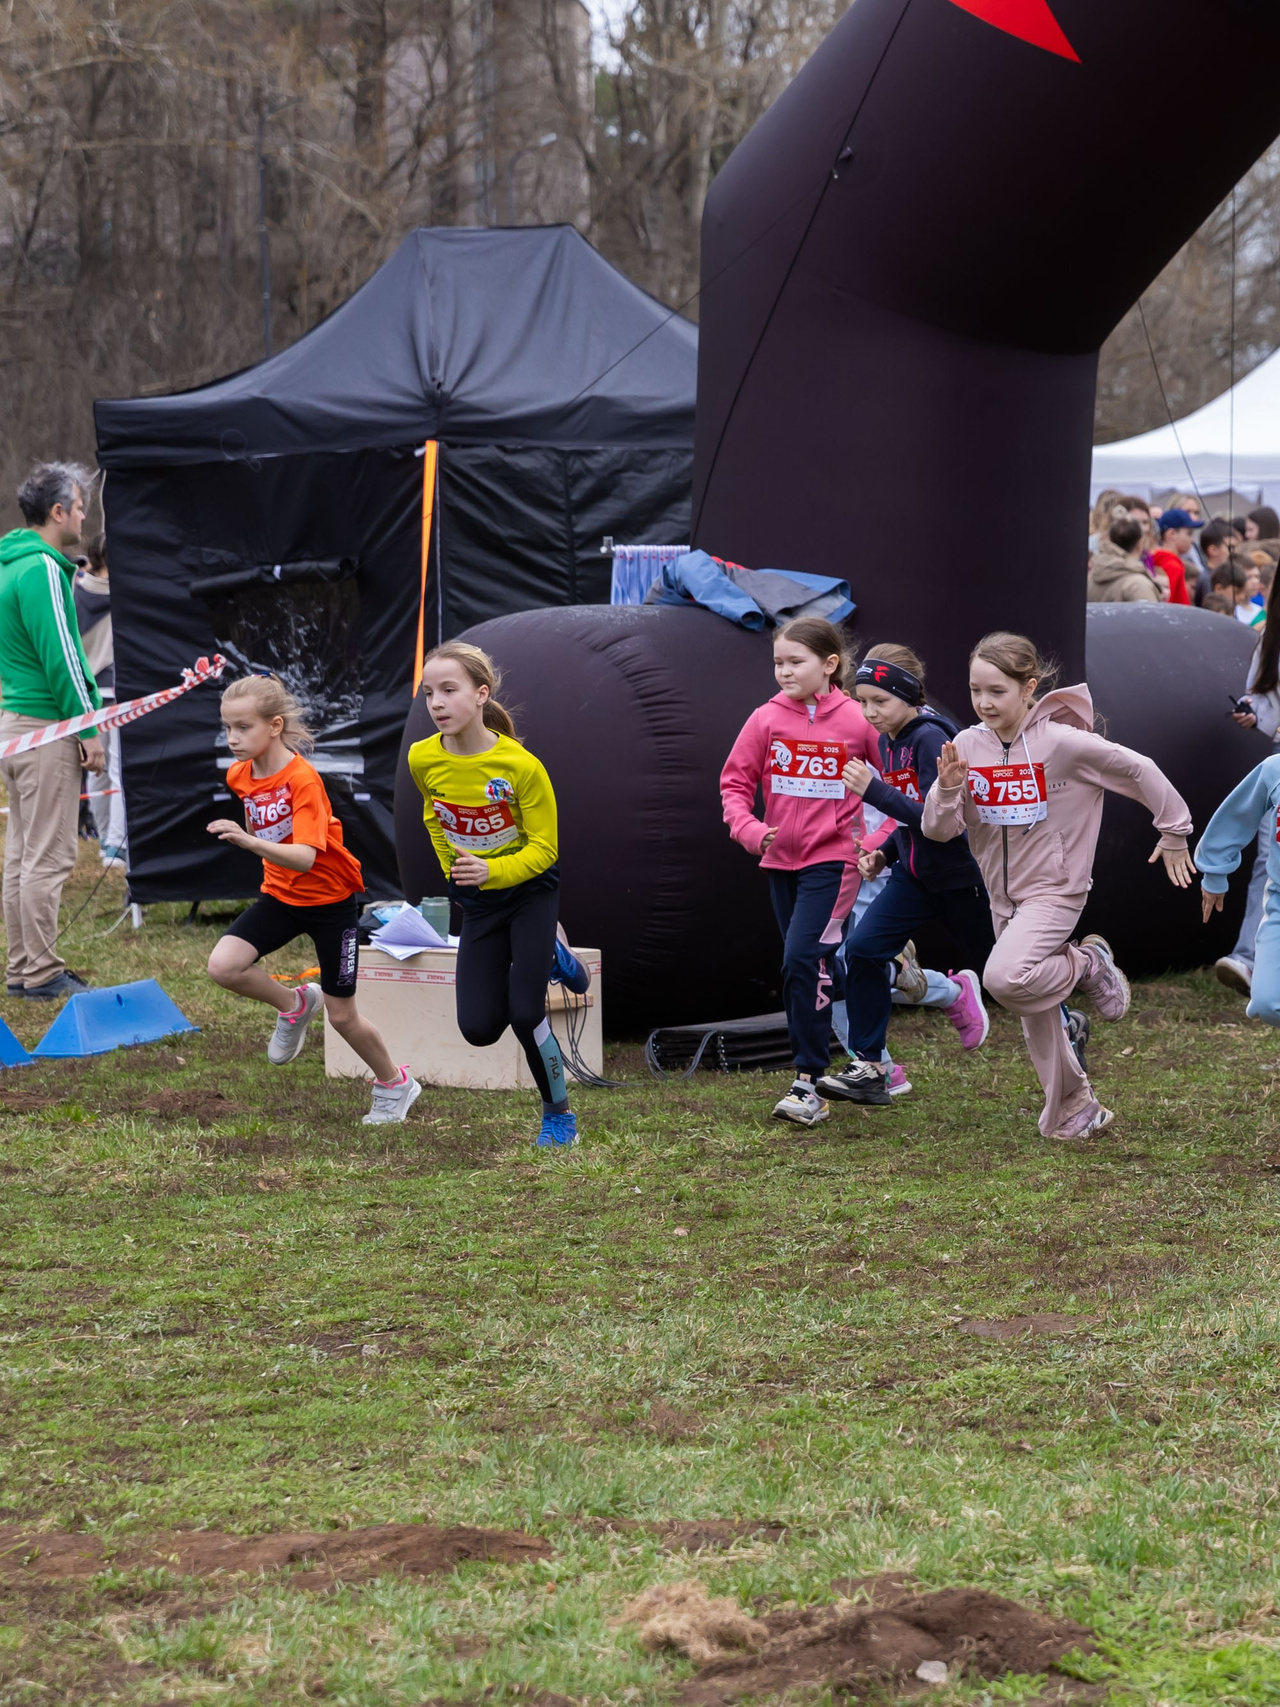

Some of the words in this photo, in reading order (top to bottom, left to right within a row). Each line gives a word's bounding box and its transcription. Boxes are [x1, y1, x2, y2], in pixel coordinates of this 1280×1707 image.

[796, 755, 838, 776] 763
[897, 772, 910, 781] 2025
[1048, 781, 1067, 789] IEVE
[993, 780, 1038, 802] 755
[257, 798, 291, 825] 766
[484, 805, 500, 813] 2025
[460, 813, 505, 833] 765
[347, 938, 357, 974] NEVER
[548, 1055, 560, 1081] FILA
